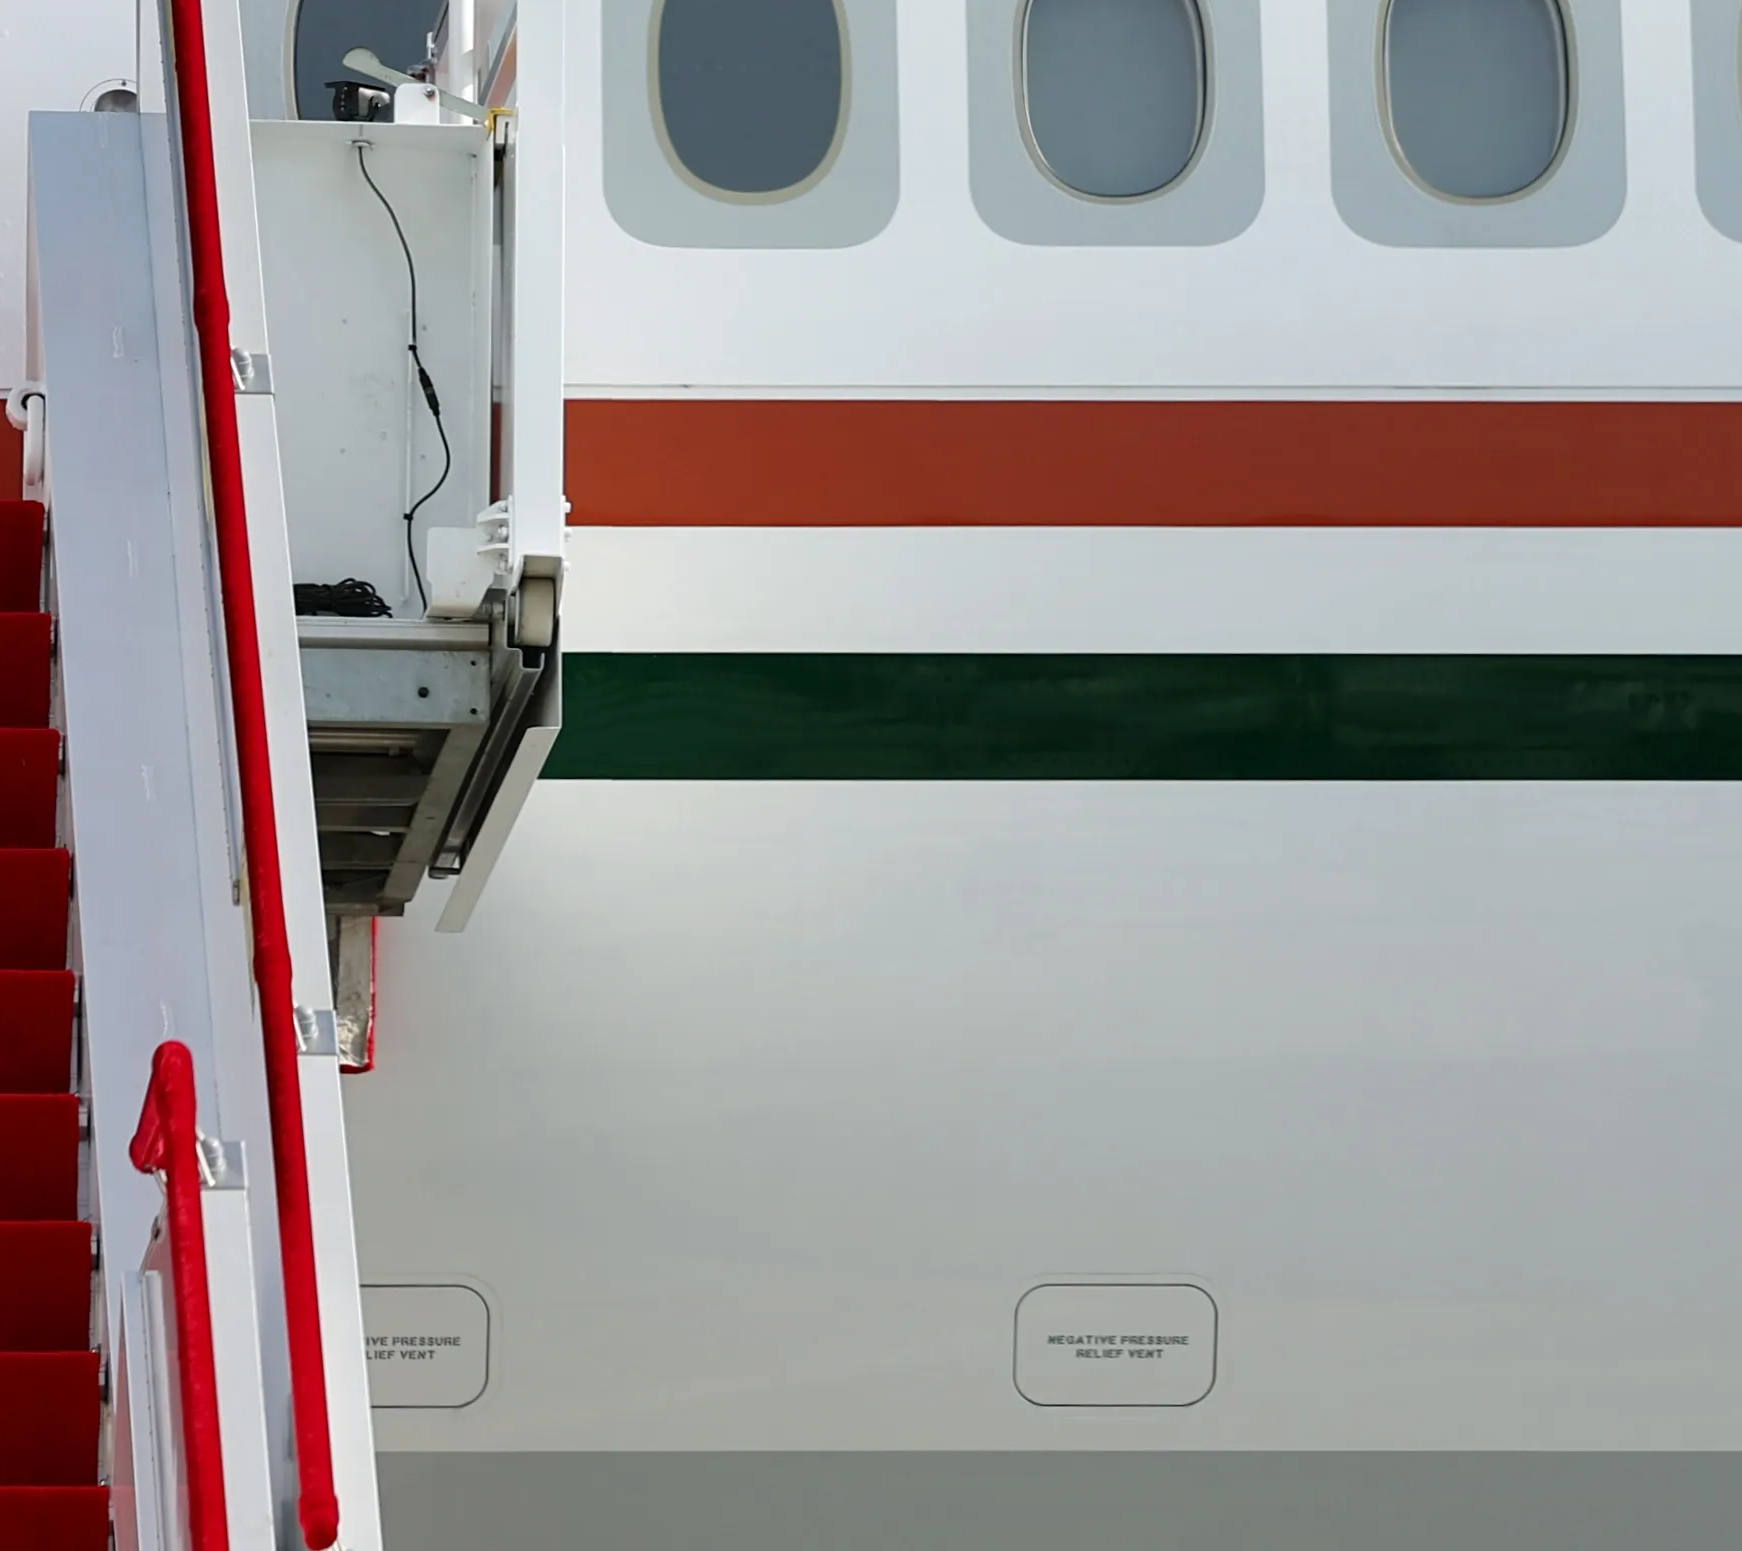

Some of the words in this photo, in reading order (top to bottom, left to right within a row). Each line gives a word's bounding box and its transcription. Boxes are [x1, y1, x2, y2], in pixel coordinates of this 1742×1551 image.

[392, 1336, 461, 1347] PRESSURE
[1047, 1335, 1117, 1346] NEGATIVE
[1120, 1335, 1189, 1346] PRESSURE
[365, 1350, 396, 1360] LIEF
[399, 1350, 436, 1360] VENT
[1075, 1349, 1124, 1359] RELIEF
[1127, 1349, 1164, 1359] VENT
